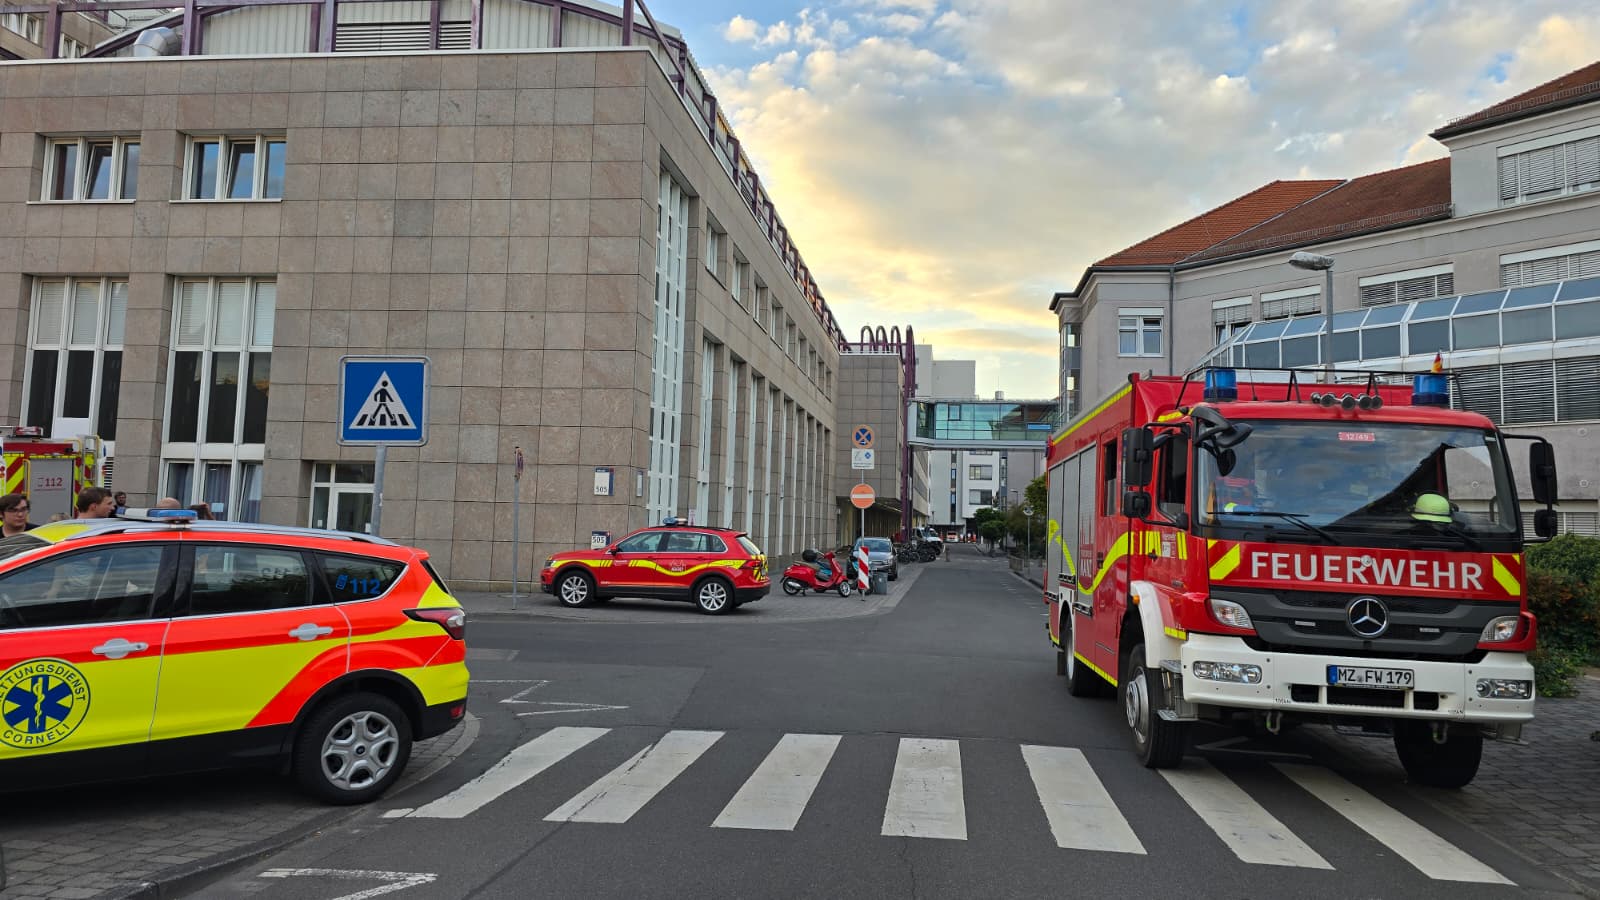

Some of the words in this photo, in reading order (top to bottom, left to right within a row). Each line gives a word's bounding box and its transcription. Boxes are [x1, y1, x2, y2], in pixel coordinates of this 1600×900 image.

[45, 477, 63, 487] 112
[592, 536, 605, 544] 505
[1251, 551, 1484, 590] FEUERWEHR
[350, 578, 381, 594] 112
[1338, 669, 1356, 682] MZ
[1365, 670, 1383, 683] FW
[1386, 671, 1412, 685] 179
[3, 723, 70, 744] CORNELI
